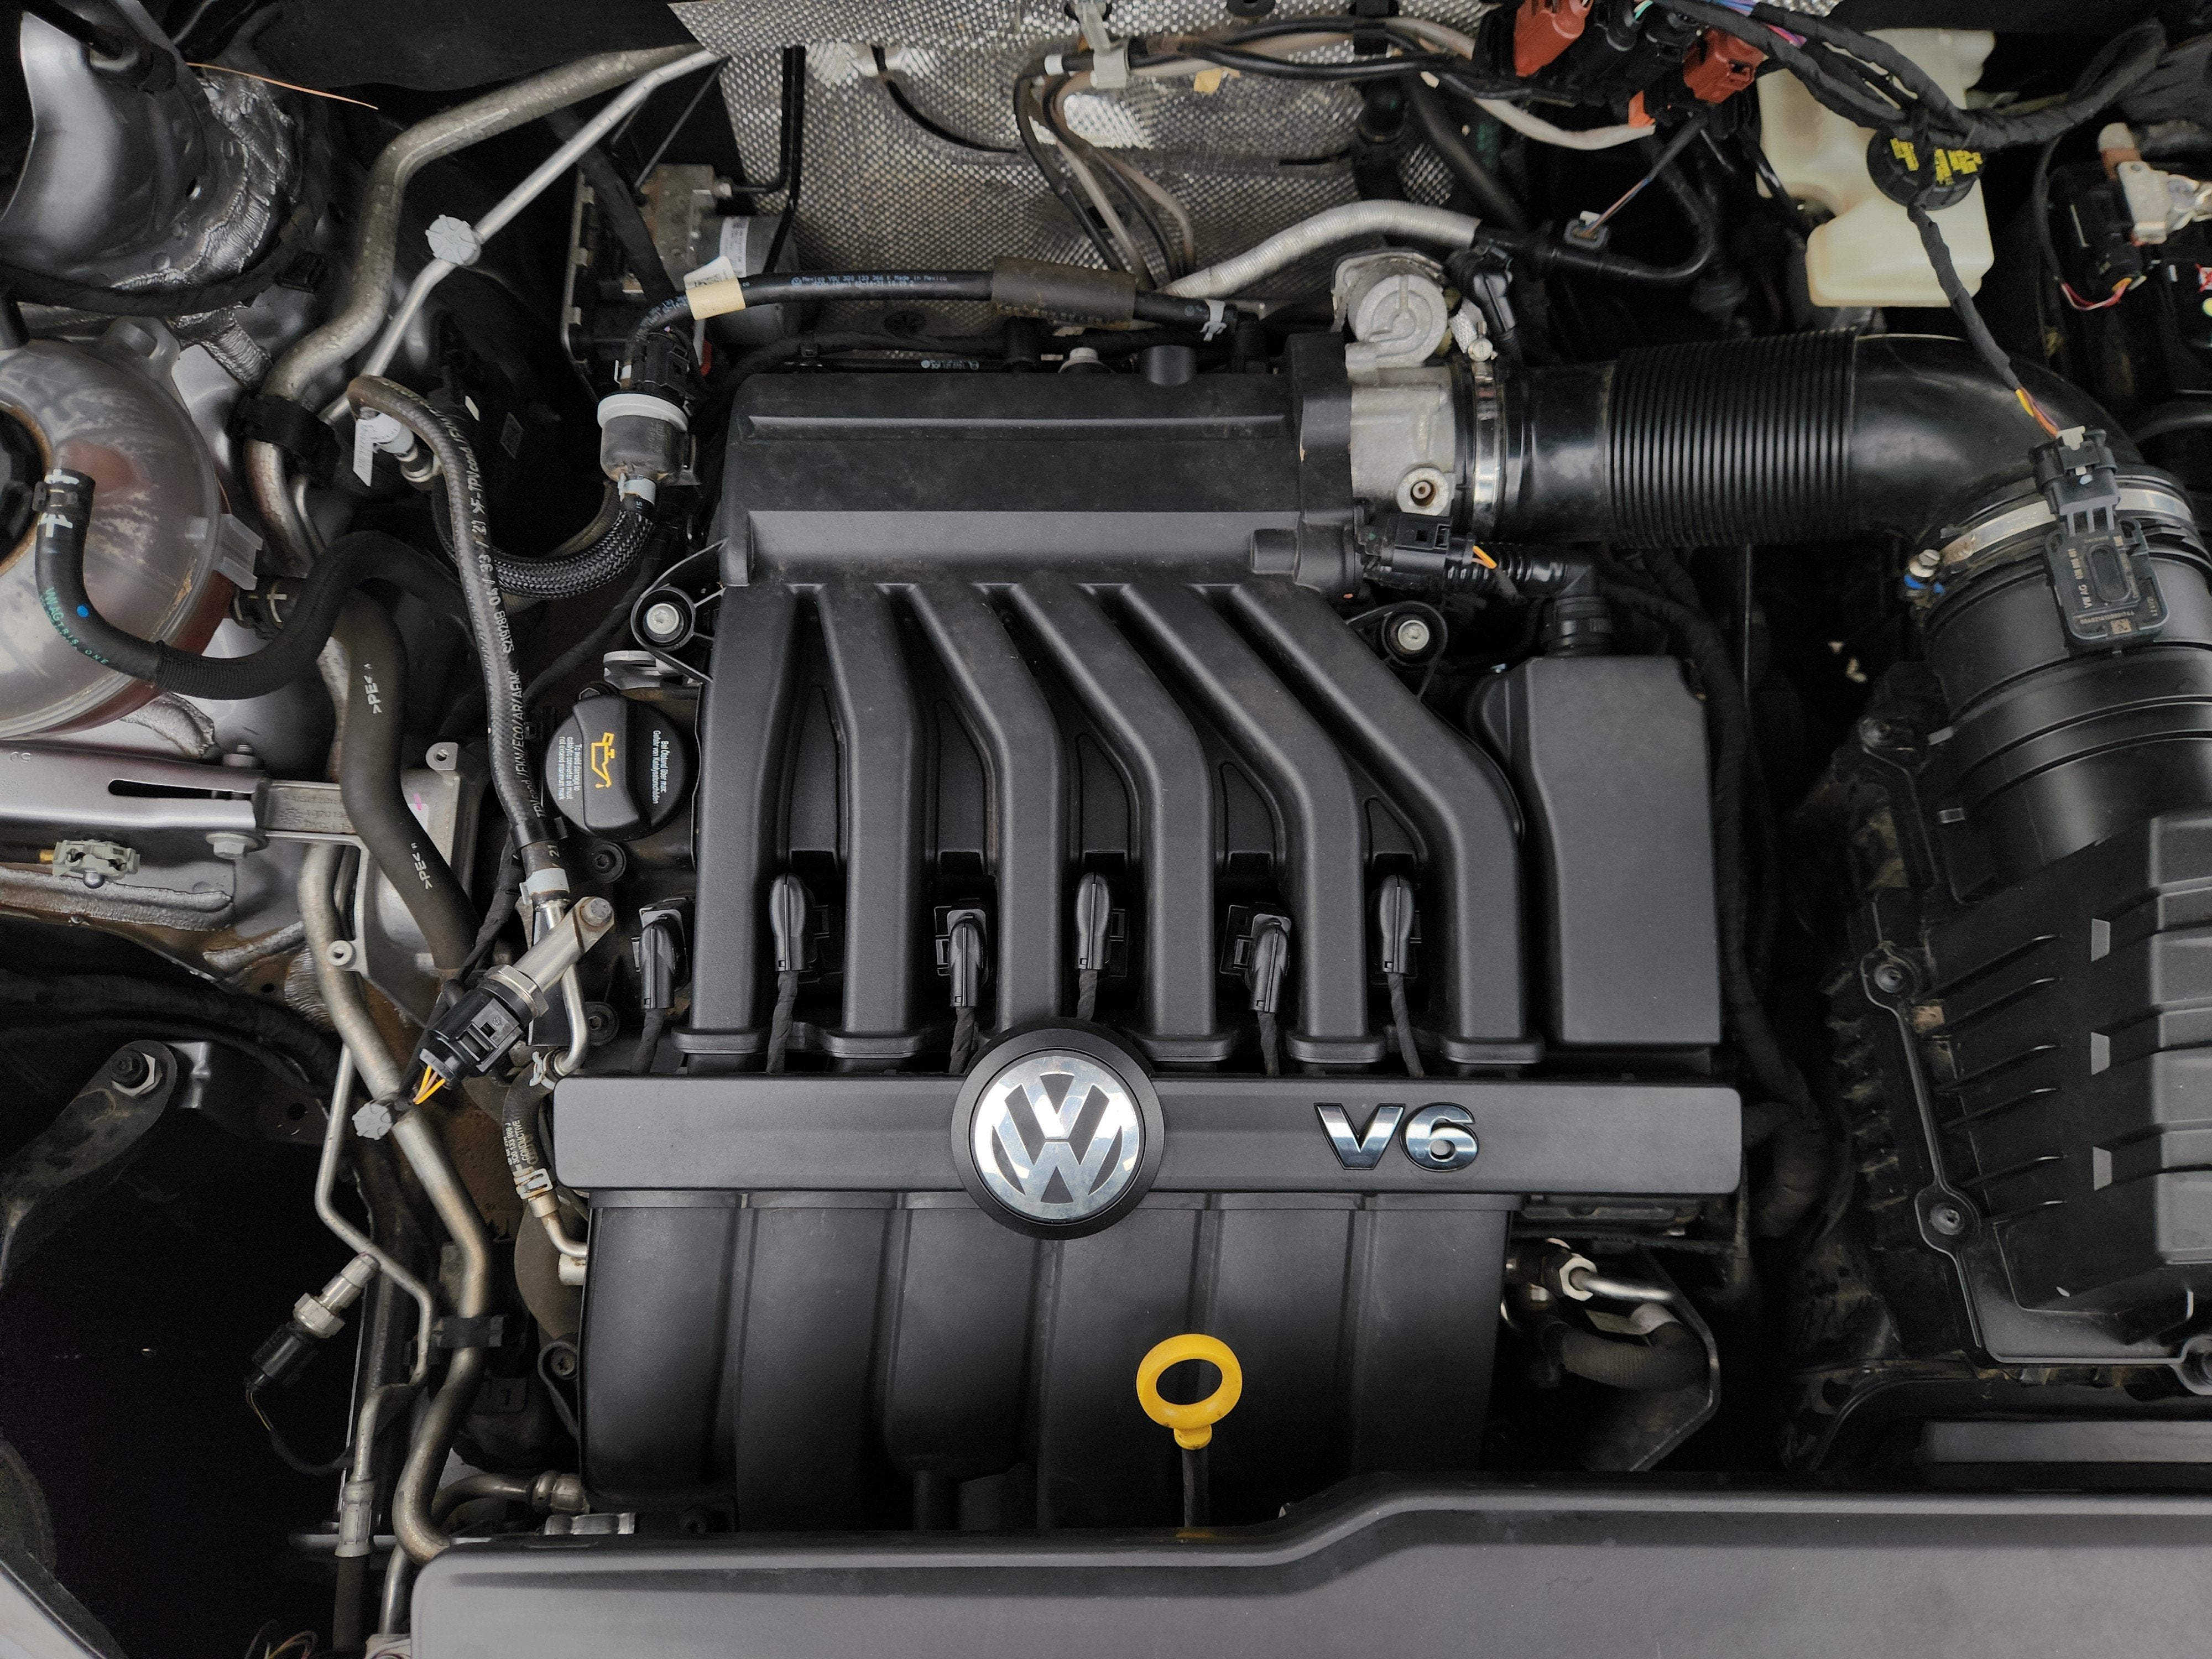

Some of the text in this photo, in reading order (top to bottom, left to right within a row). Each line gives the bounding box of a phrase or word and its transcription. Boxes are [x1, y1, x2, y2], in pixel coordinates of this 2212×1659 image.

[573, 751, 582, 765] avoid
[660, 750, 670, 768] Ölstand
[572, 765, 582, 785] damage
[650, 757, 660, 804] Katalysatorschäden
[512, 1120, 528, 1161] CONDUCTIVE
[1314, 1102, 1480, 1172] V6
